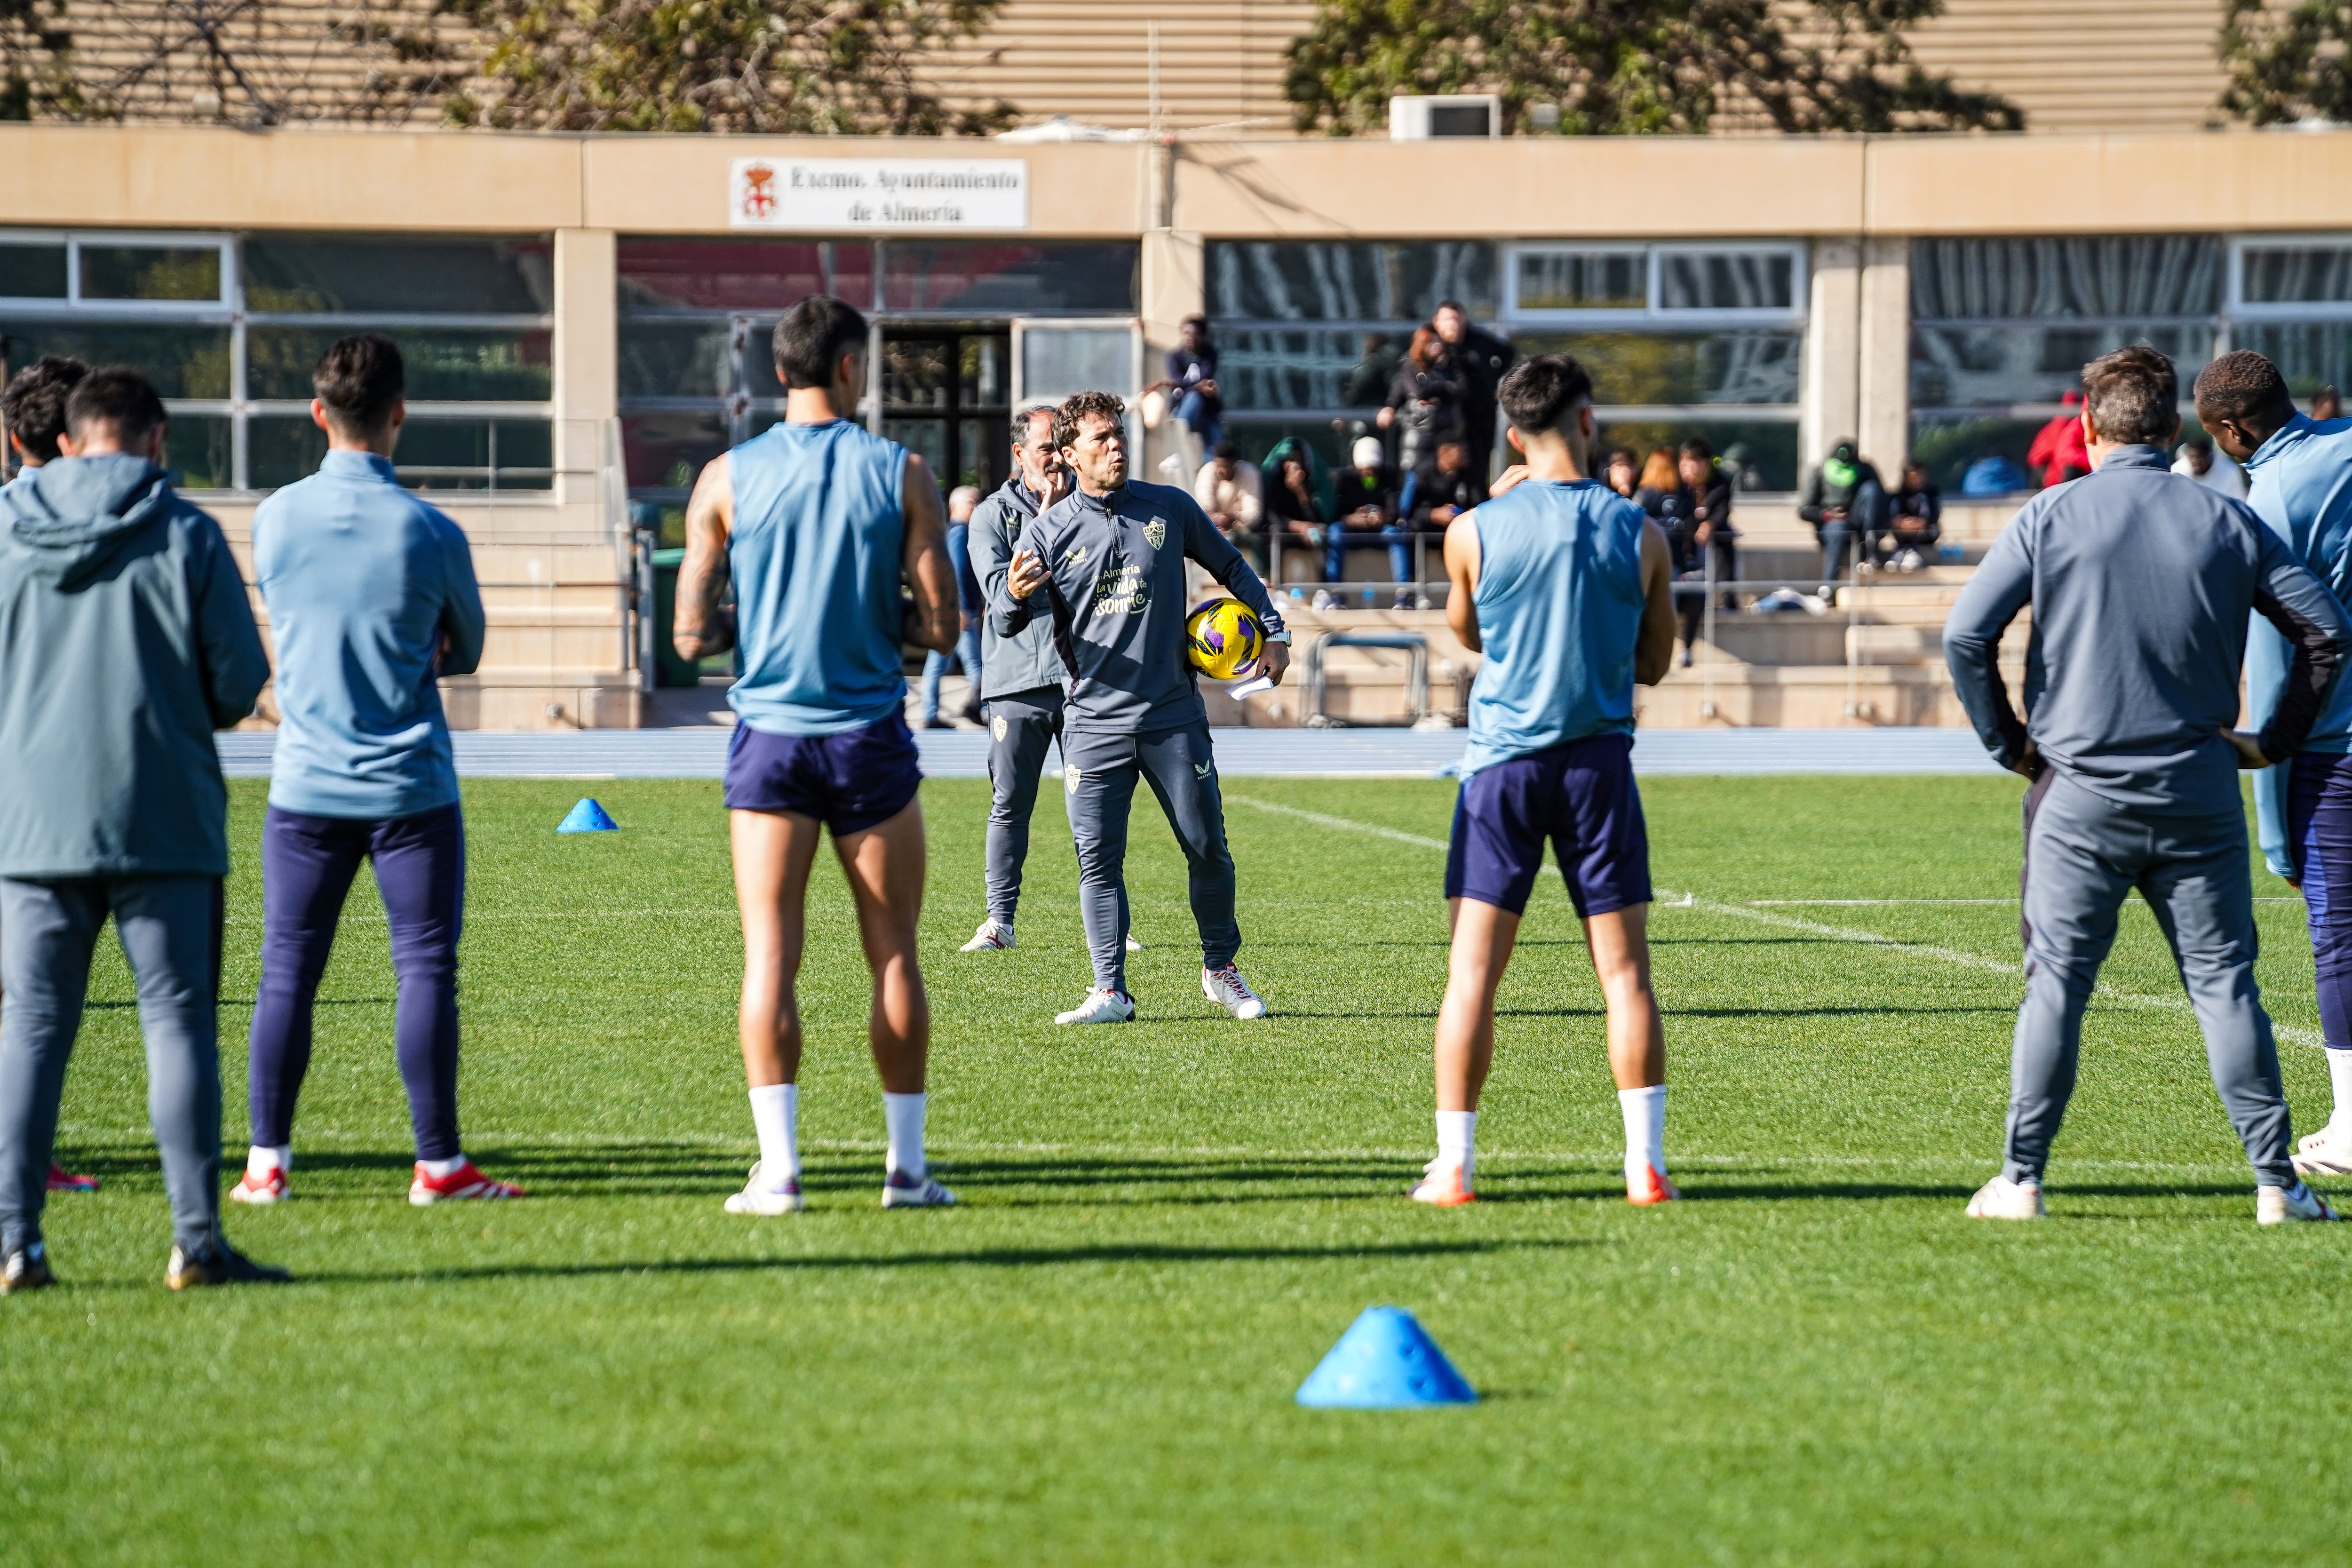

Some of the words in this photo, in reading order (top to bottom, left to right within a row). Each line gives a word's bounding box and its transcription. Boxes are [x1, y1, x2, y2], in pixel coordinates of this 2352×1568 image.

[791, 166, 868, 188] Excmo.
[873, 167, 1018, 194] Ayuntamiento
[849, 200, 871, 222] de
[1107, 575, 1138, 594] vida
[1139, 577, 1147, 588] te
